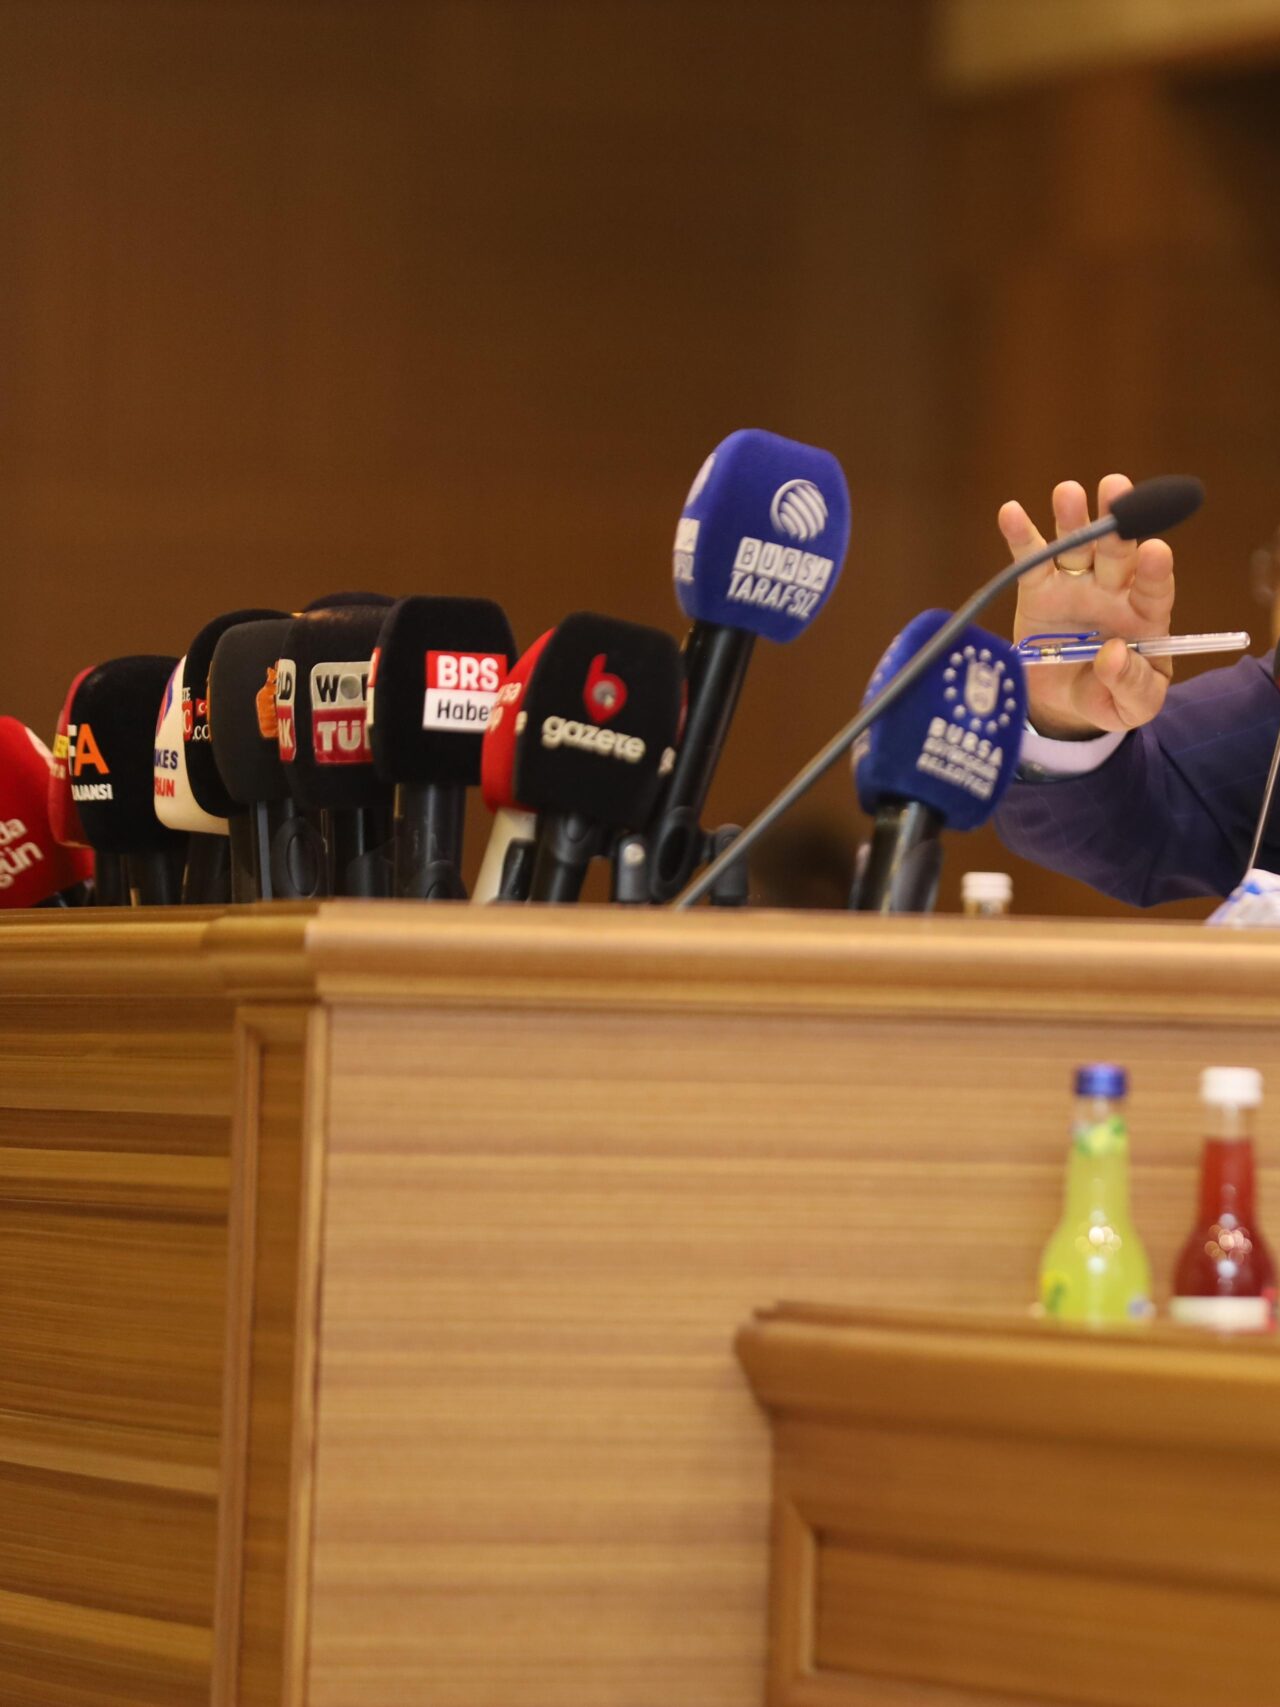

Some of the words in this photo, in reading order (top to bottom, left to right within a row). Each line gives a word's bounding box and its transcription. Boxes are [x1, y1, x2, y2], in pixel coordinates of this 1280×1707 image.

[736, 537, 833, 591] BURSA
[727, 570, 820, 618] TARAFSIZ
[437, 654, 499, 691] BRS
[437, 699, 494, 721] Habe
[542, 715, 646, 763] gazete
[927, 716, 1003, 768] BURSA
